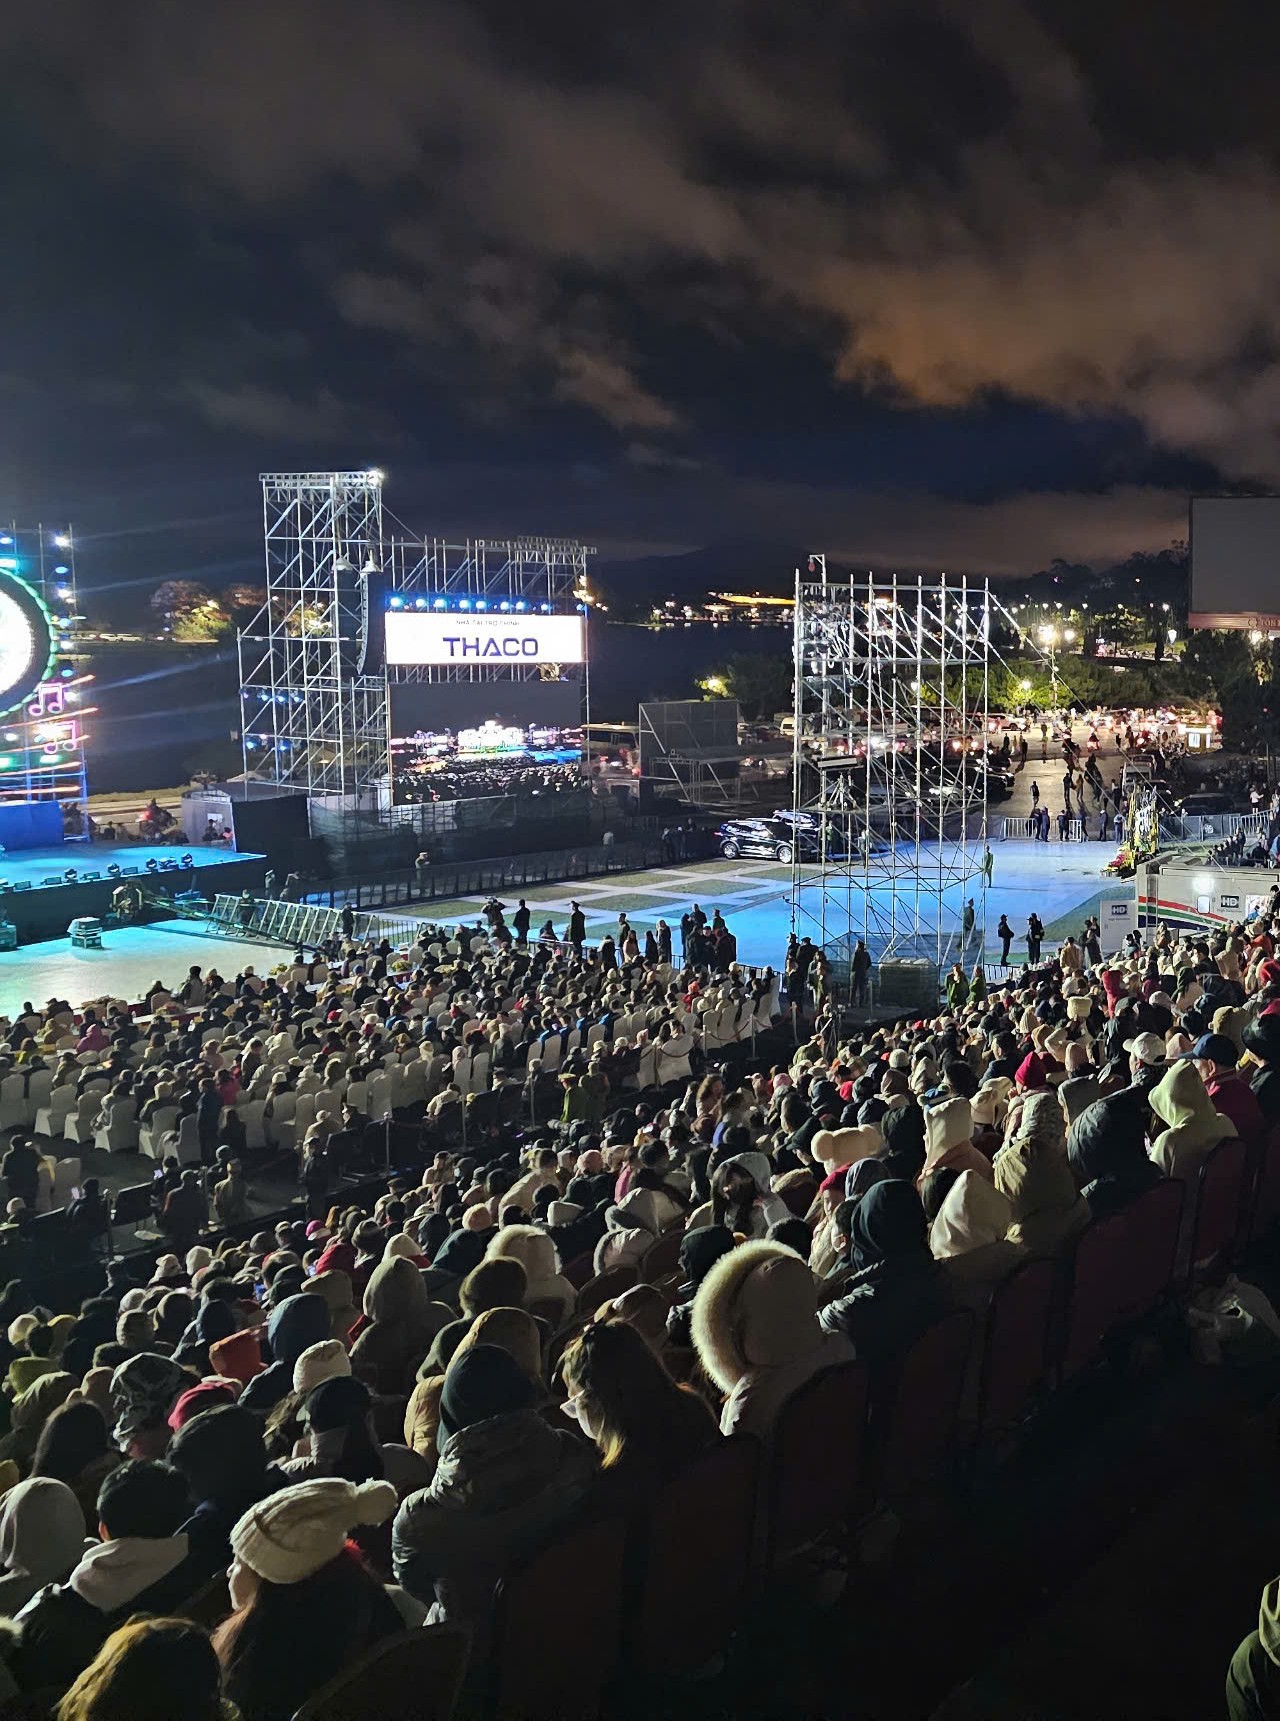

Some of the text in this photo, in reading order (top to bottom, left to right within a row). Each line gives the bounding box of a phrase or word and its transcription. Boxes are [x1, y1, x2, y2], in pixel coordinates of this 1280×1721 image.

[443, 637, 538, 656] THACO
[1222, 896, 1238, 907] HD
[1112, 906, 1126, 914] HD
